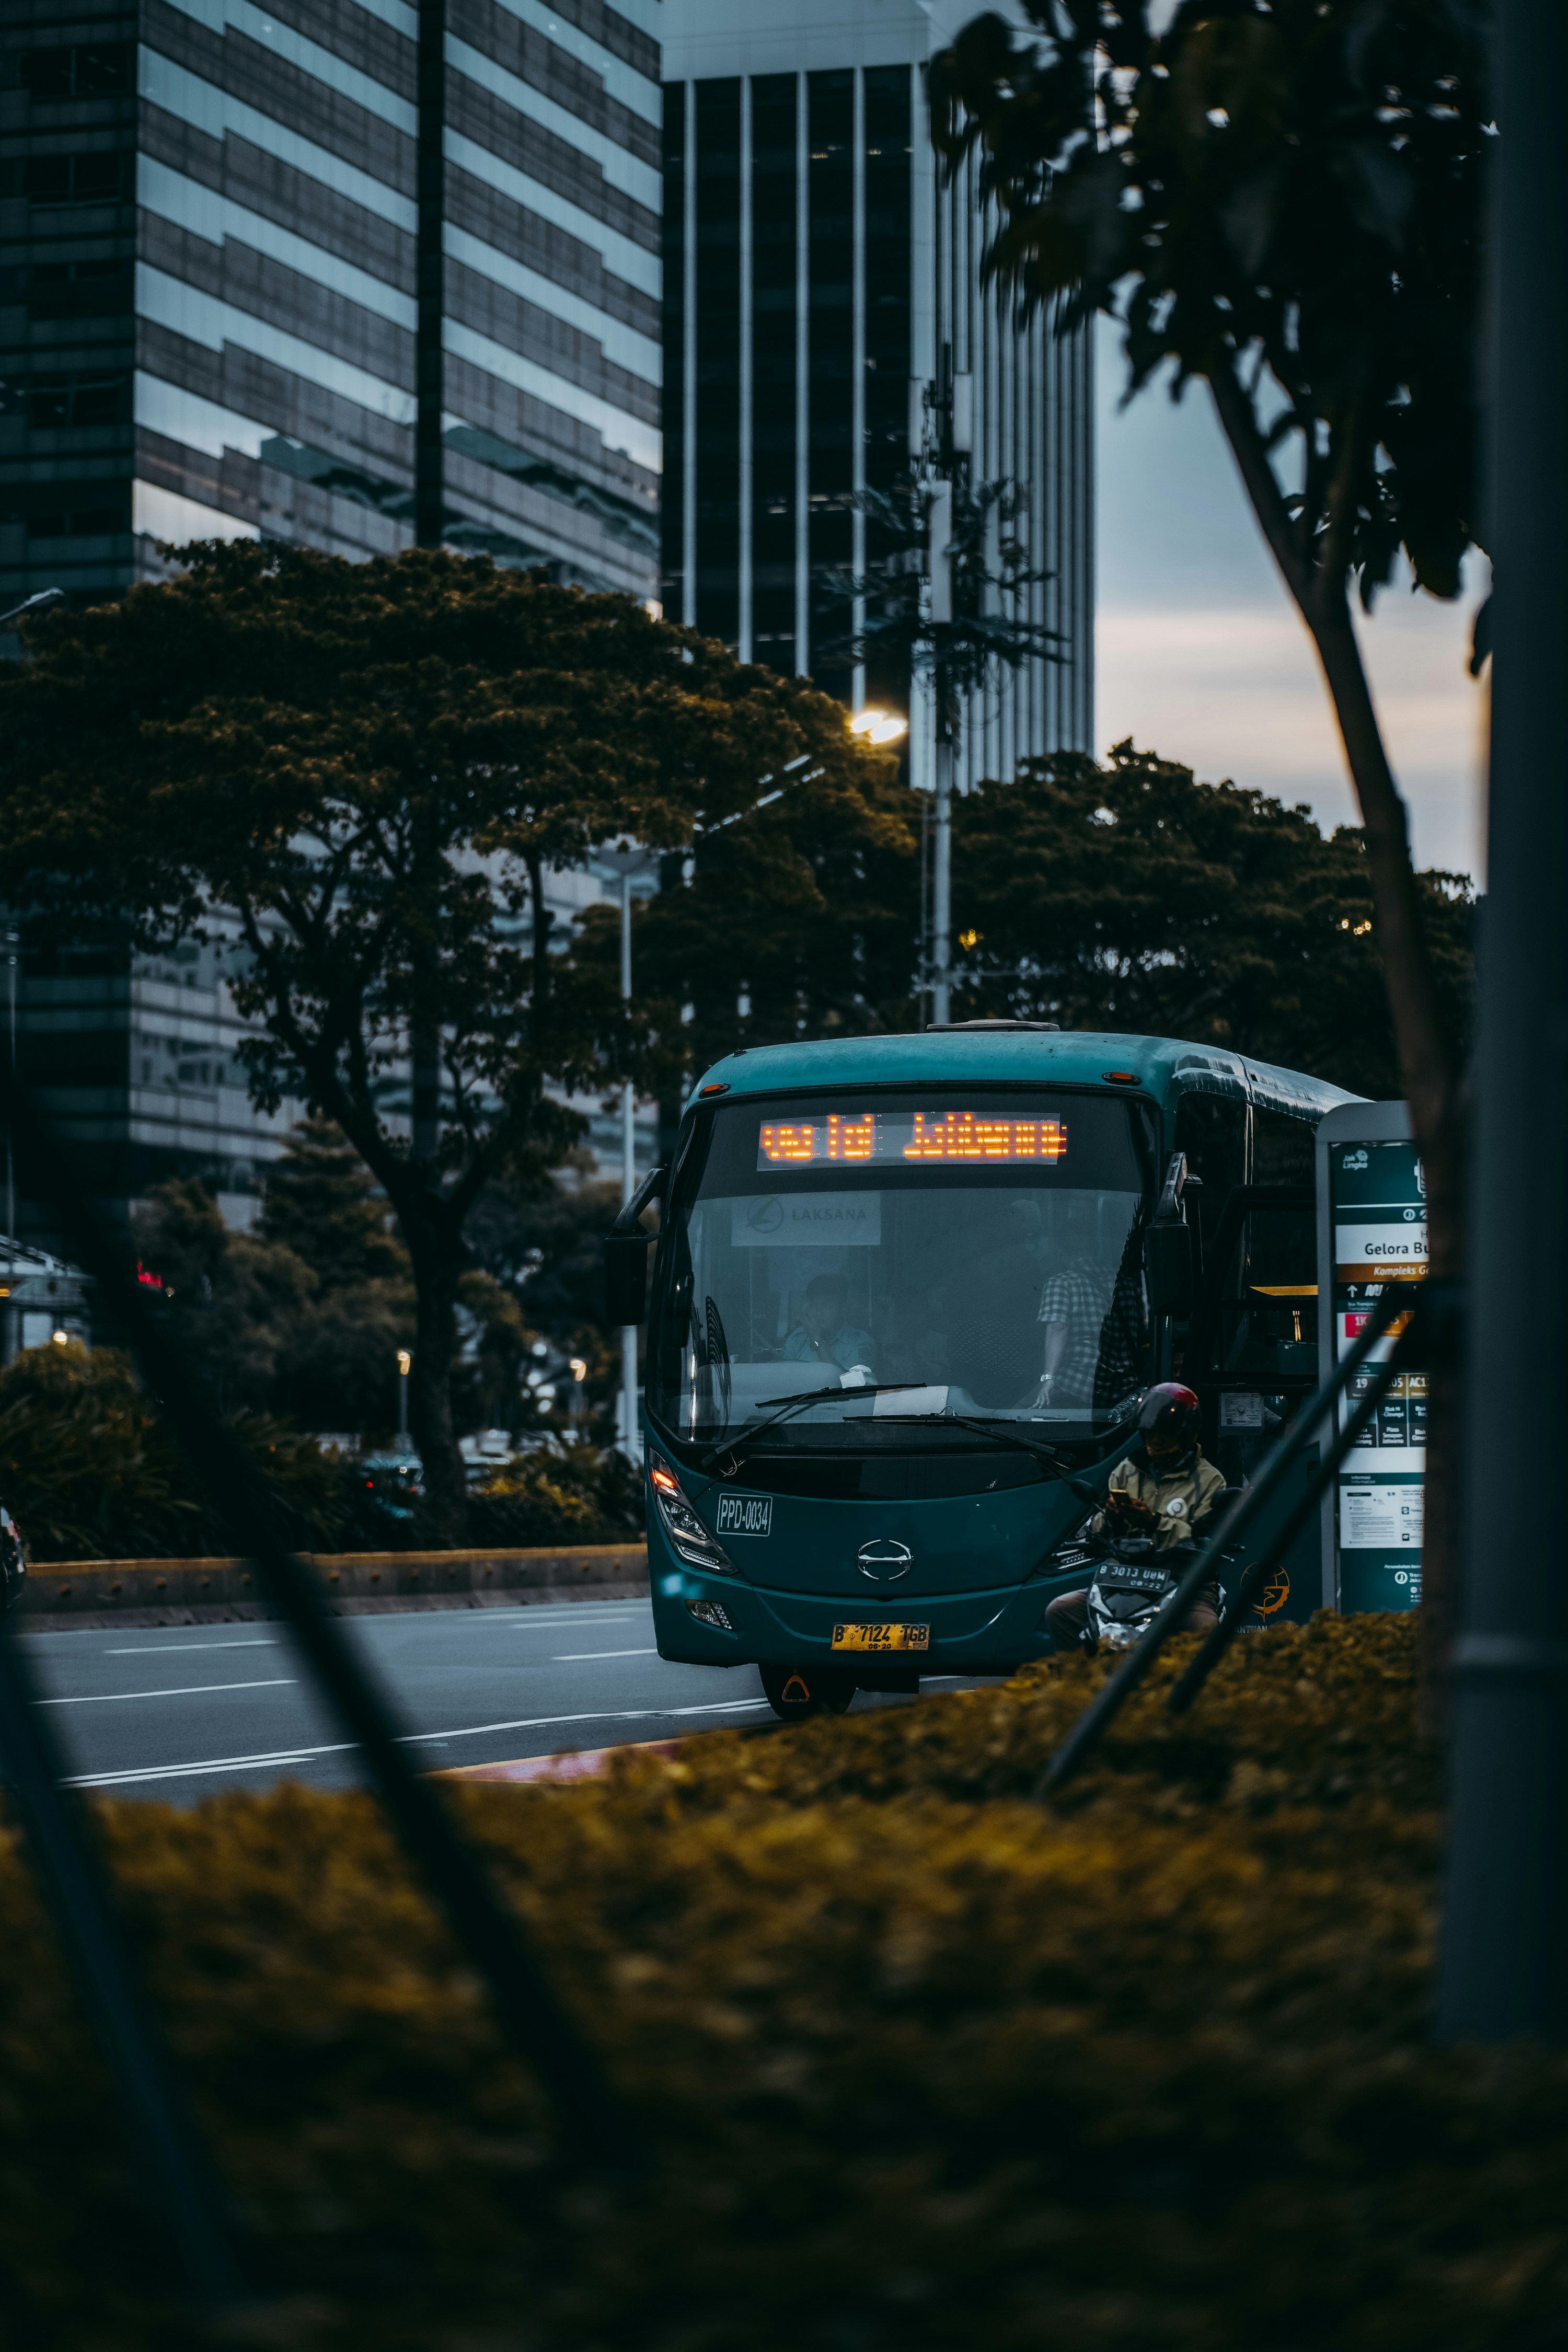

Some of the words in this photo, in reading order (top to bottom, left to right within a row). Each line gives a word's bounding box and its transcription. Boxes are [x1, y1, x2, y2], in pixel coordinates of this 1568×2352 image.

[1343, 1162, 1368, 1170] Lingko
[791, 1209, 866, 1221] LAKSANA
[1365, 1243, 1409, 1255] Gelora
[1374, 1266, 1416, 1277] Kompleks
[1356, 1378, 1368, 1388] 19
[1388, 1377, 1403, 1388] 05
[1409, 1377, 1429, 1388] AC1
[720, 1499, 768, 1530] PPD-0034
[1111, 1566, 1138, 1577] 3013
[835, 1625, 844, 1642] B
[860, 1625, 890, 1642] 7124
[902, 1625, 927, 1642] TGB
